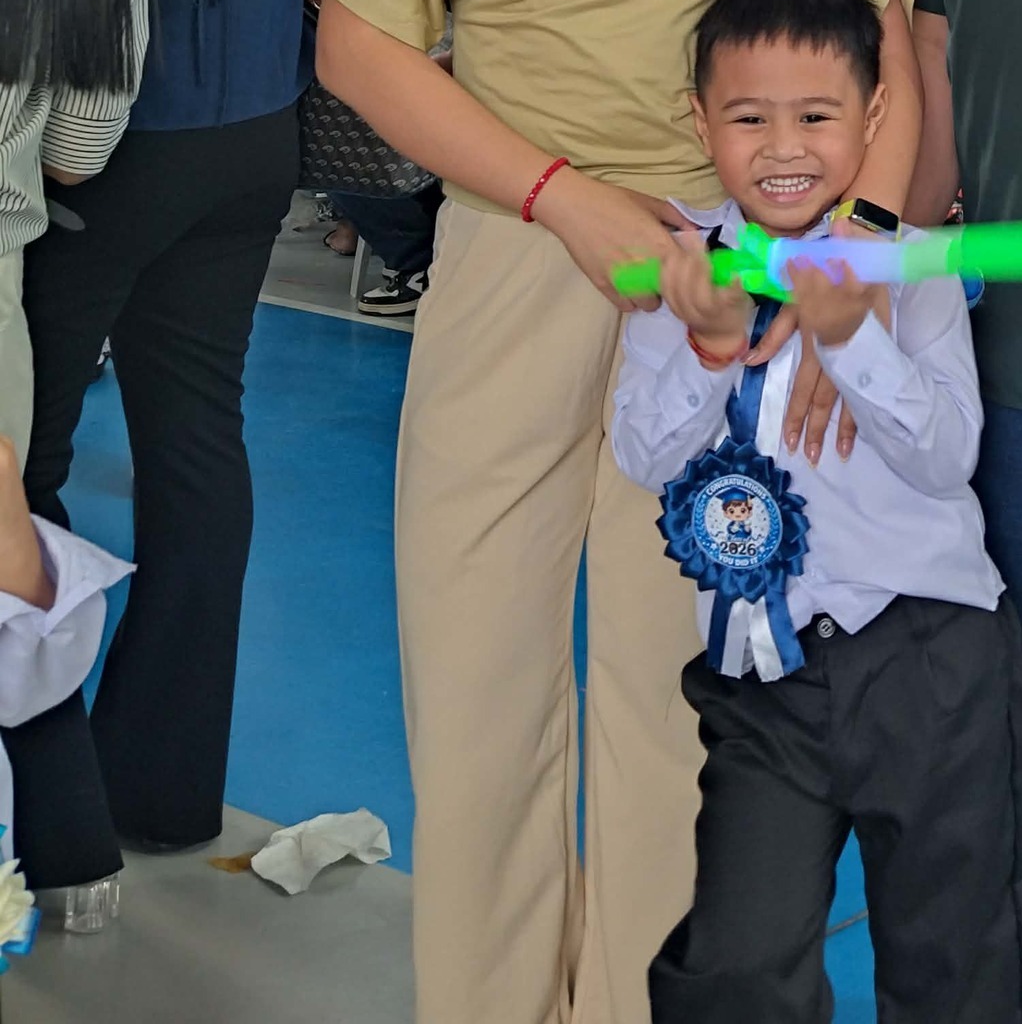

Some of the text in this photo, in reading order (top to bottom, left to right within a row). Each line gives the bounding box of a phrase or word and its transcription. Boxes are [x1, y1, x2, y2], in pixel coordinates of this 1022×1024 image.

[706, 478, 767, 500] CONGRATULATIONS
[720, 541, 757, 556] 2026
[719, 556, 735, 565] YOU
[734, 558, 749, 566] DID
